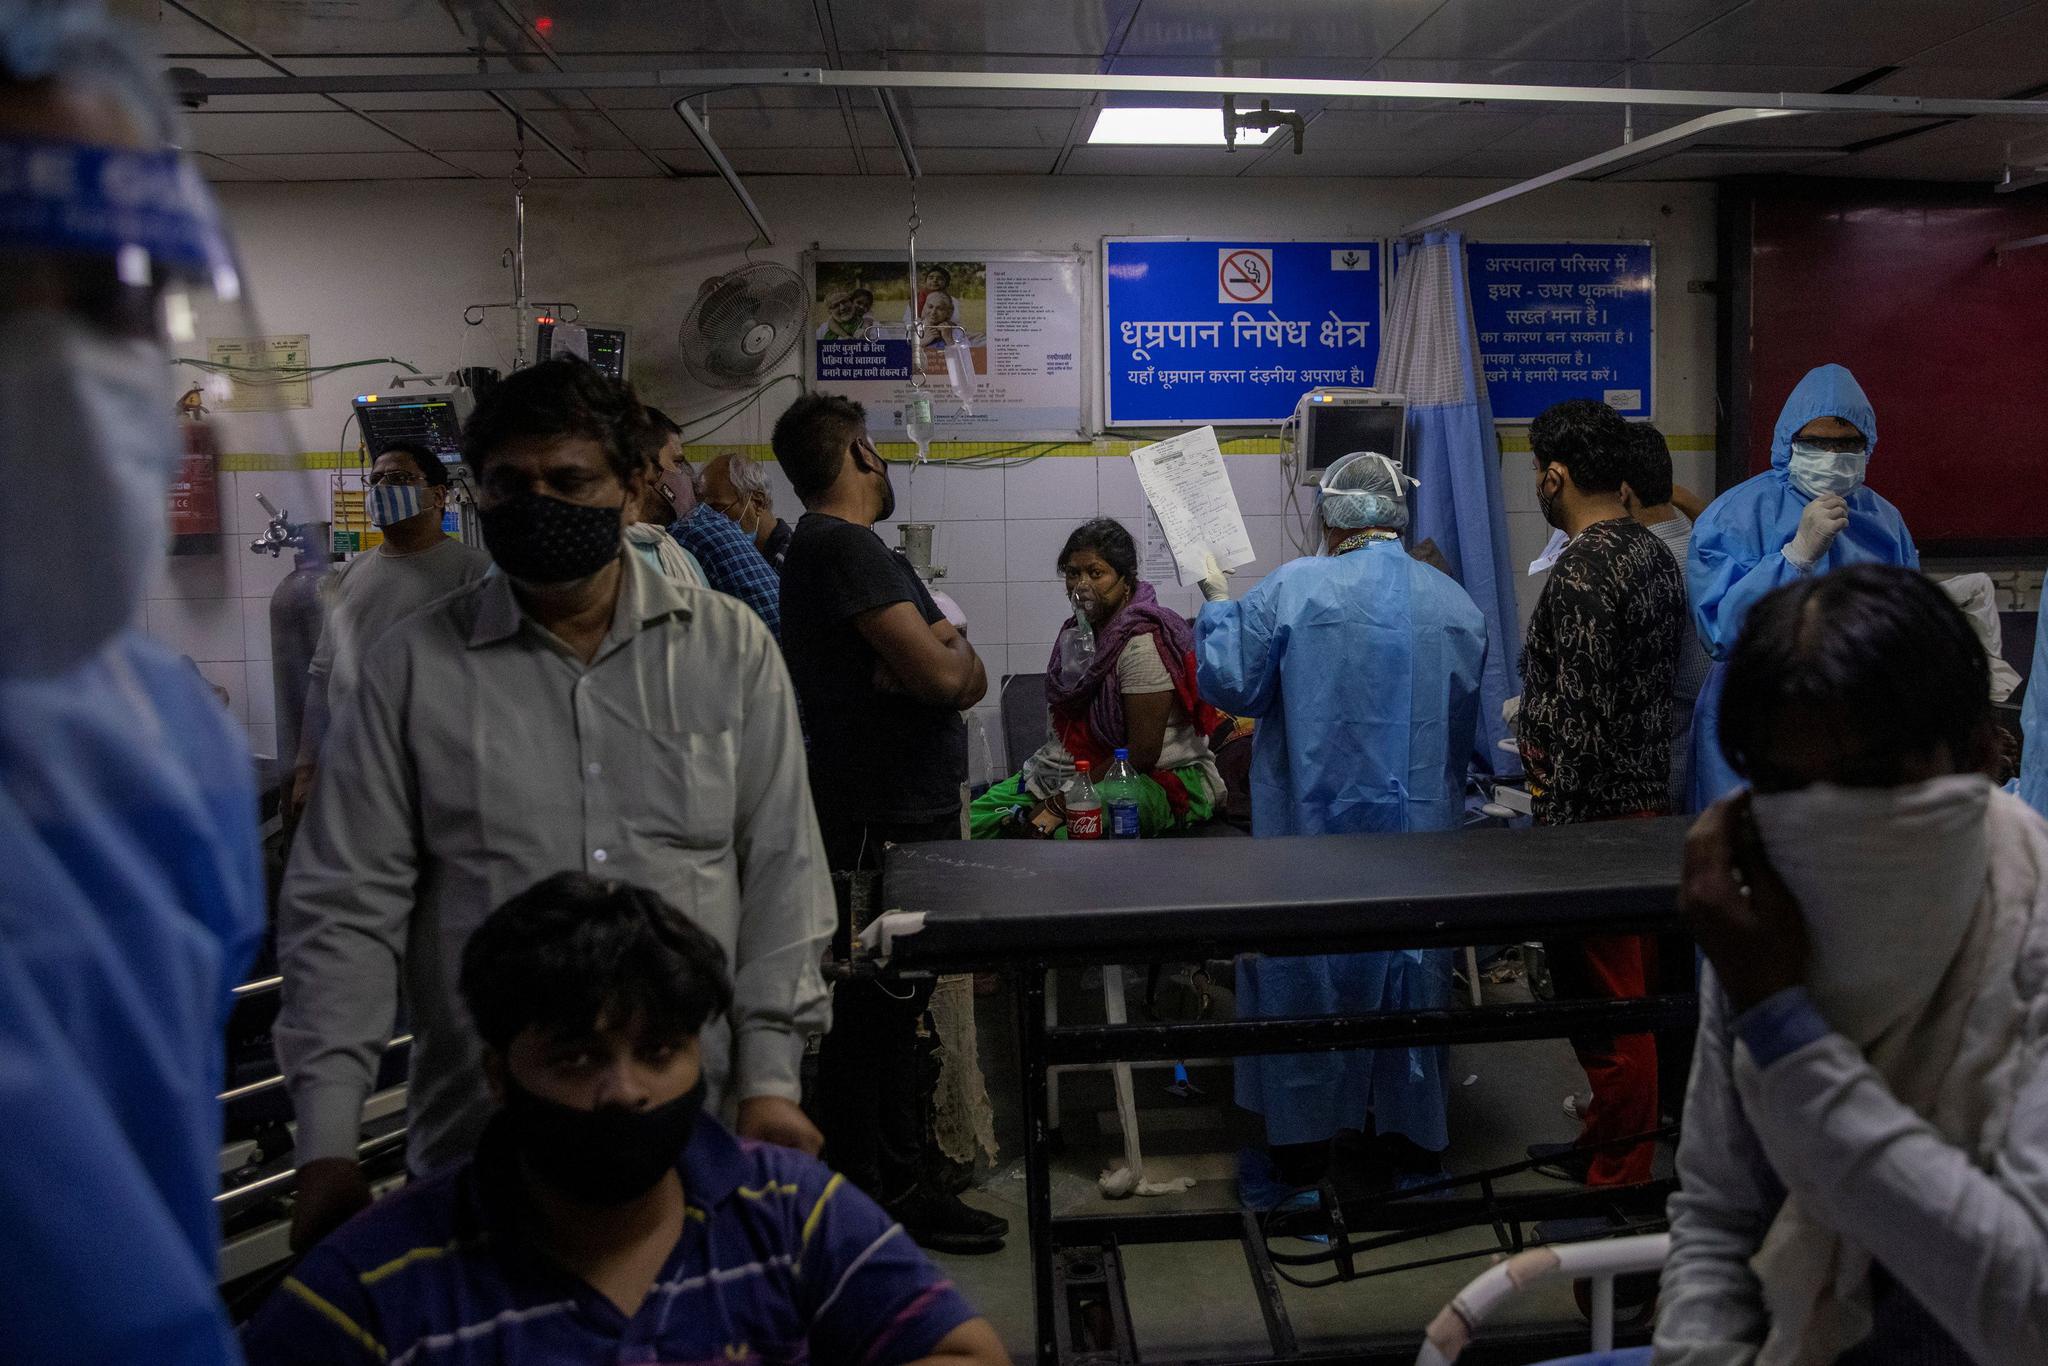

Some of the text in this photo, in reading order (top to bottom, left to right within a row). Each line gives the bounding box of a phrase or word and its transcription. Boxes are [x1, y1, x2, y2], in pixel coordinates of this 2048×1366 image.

[1485, 253, 1627, 273] अस्पताल परिसर में
[1488, 283, 1523, 301] इधर
[1537, 283, 1575, 299] उधर
[1578, 283, 1624, 306] थूकना
[1506, 309, 1547, 325] सख्त
[1551, 309, 1582, 325] मना
[1119, 310, 1370, 361] धूम्रपान निषेध क्षेत्र
[1503, 331, 1541, 344] कारण
[1545, 331, 1566, 344] बन
[1570, 331, 1611, 344] सकता
[1518, 353, 1572, 366] अस्पताल
[1127, 365, 1156, 385] यहाँ
[1158, 369, 1206, 390] धूम्रपान
[1208, 369, 1246, 384] करना
[1300, 369, 1347, 385] अपराध
[1511, 367, 1522, 382] में
[1524, 367, 1559, 384] हमारी
[1561, 370, 1588, 382] मदद
